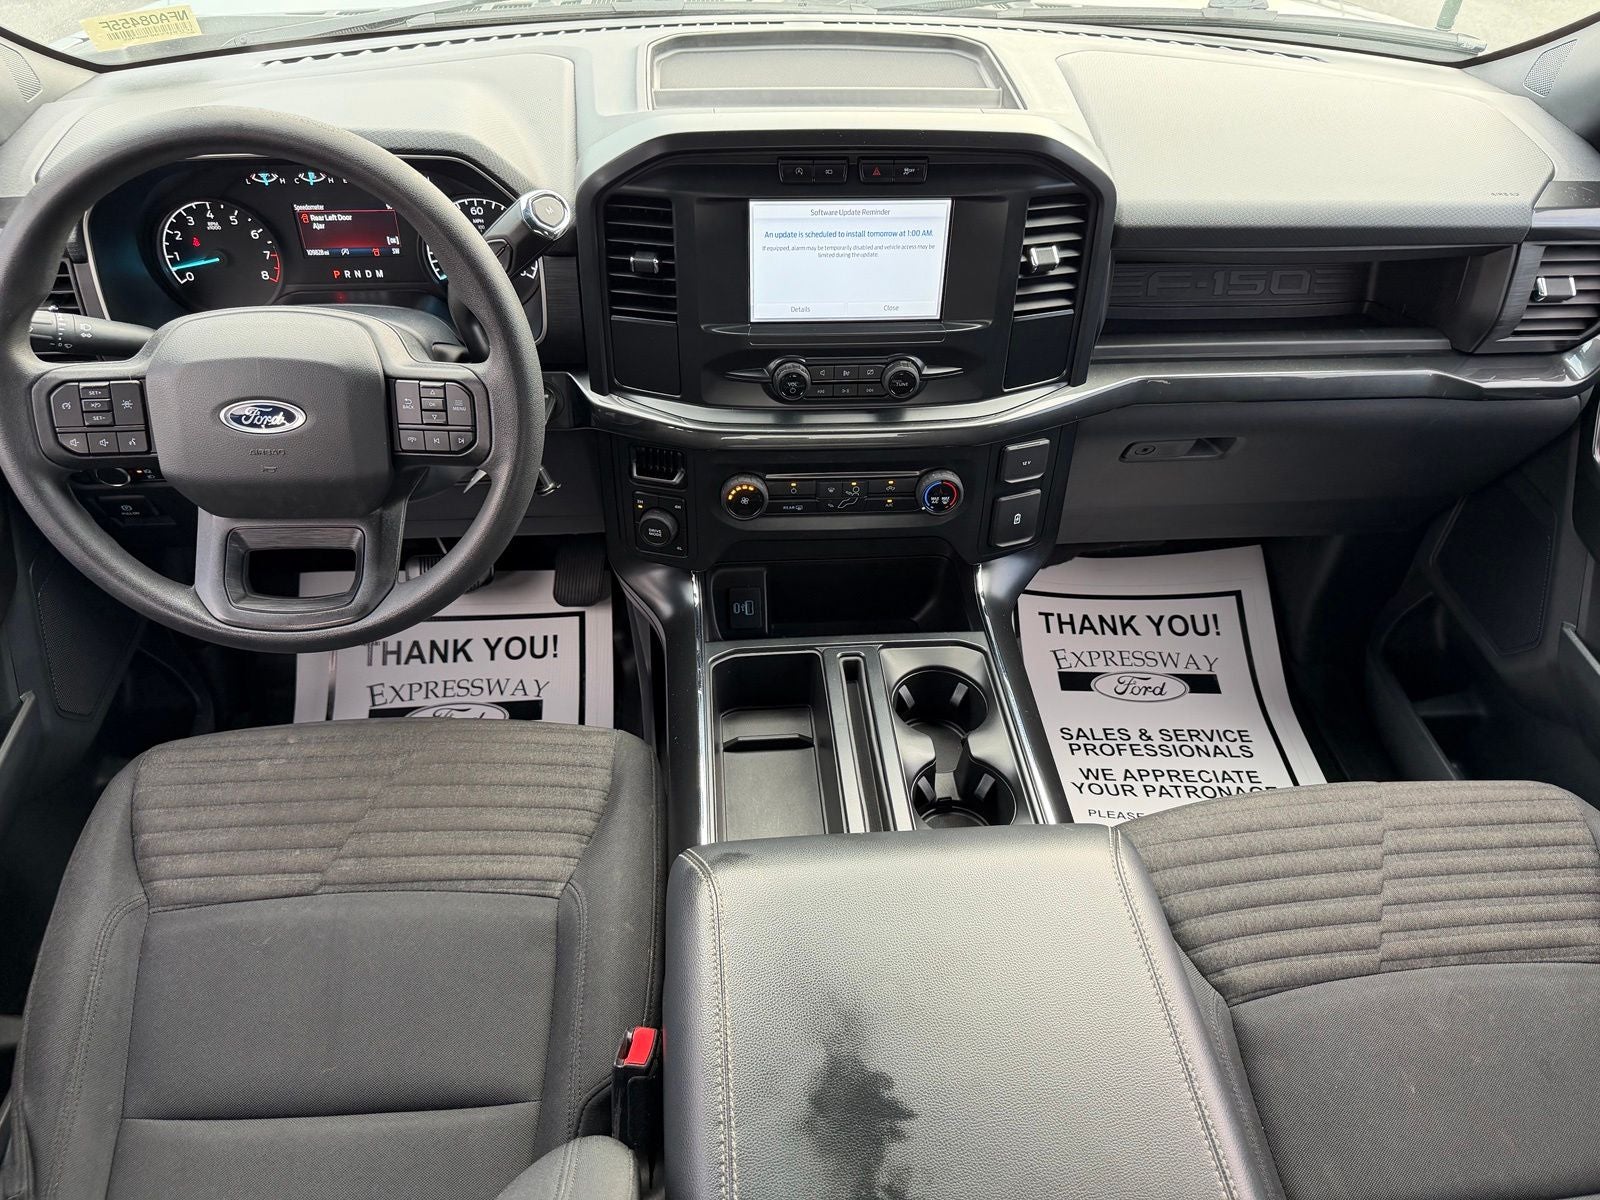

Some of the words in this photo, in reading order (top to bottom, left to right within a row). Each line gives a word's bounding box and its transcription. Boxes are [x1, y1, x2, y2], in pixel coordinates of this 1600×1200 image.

[293, 203, 325, 211] Speedometer
[470, 206, 484, 215] 60
[206, 209, 215, 219] 4
[810, 208, 837, 216] Software
[838, 208, 860, 217] Update
[861, 208, 891, 216] Reminder
[185, 216, 195, 226] 3
[229, 215, 239, 226] 5
[312, 222, 325, 230] Ajar
[173, 230, 183, 240] 2
[250, 229, 260, 240] 6
[774, 231, 798, 239] update
[845, 230, 865, 238] install
[867, 230, 898, 238] tomorrow
[907, 229, 921, 237] 1:00
[174, 251, 180, 261] 1
[263, 250, 271, 260] 7
[185, 272, 195, 281] 0
[261, 271, 270, 280] 8
[333, 270, 341, 279] P
[344, 270, 351, 279] R
[354, 270, 362, 278] N
[365, 270, 373, 278] D
[375, 269, 384, 278] M
[1147, 270, 1312, 297] F-150
[790, 305, 811, 313] Details
[883, 304, 900, 312] Close
[241, 406, 288, 428] Ford
[1038, 612, 1141, 637] THANK
[1146, 613, 1221, 637] YOU!
[360, 637, 474, 667] THANK
[482, 634, 559, 660] YOU!
[1113, 674, 1168, 697] Ford
[1060, 727, 1132, 741] SALES
[1138, 728, 1154, 742] &
[1158, 728, 1253, 743] SERVICE
[1068, 742, 1254, 759] PROFESSIONALS
[1078, 767, 1117, 782] WE
[1122, 768, 1263, 784] APPRECIATE
[1071, 781, 1138, 798] YOUR
[1143, 784, 1277, 799] PATRON
